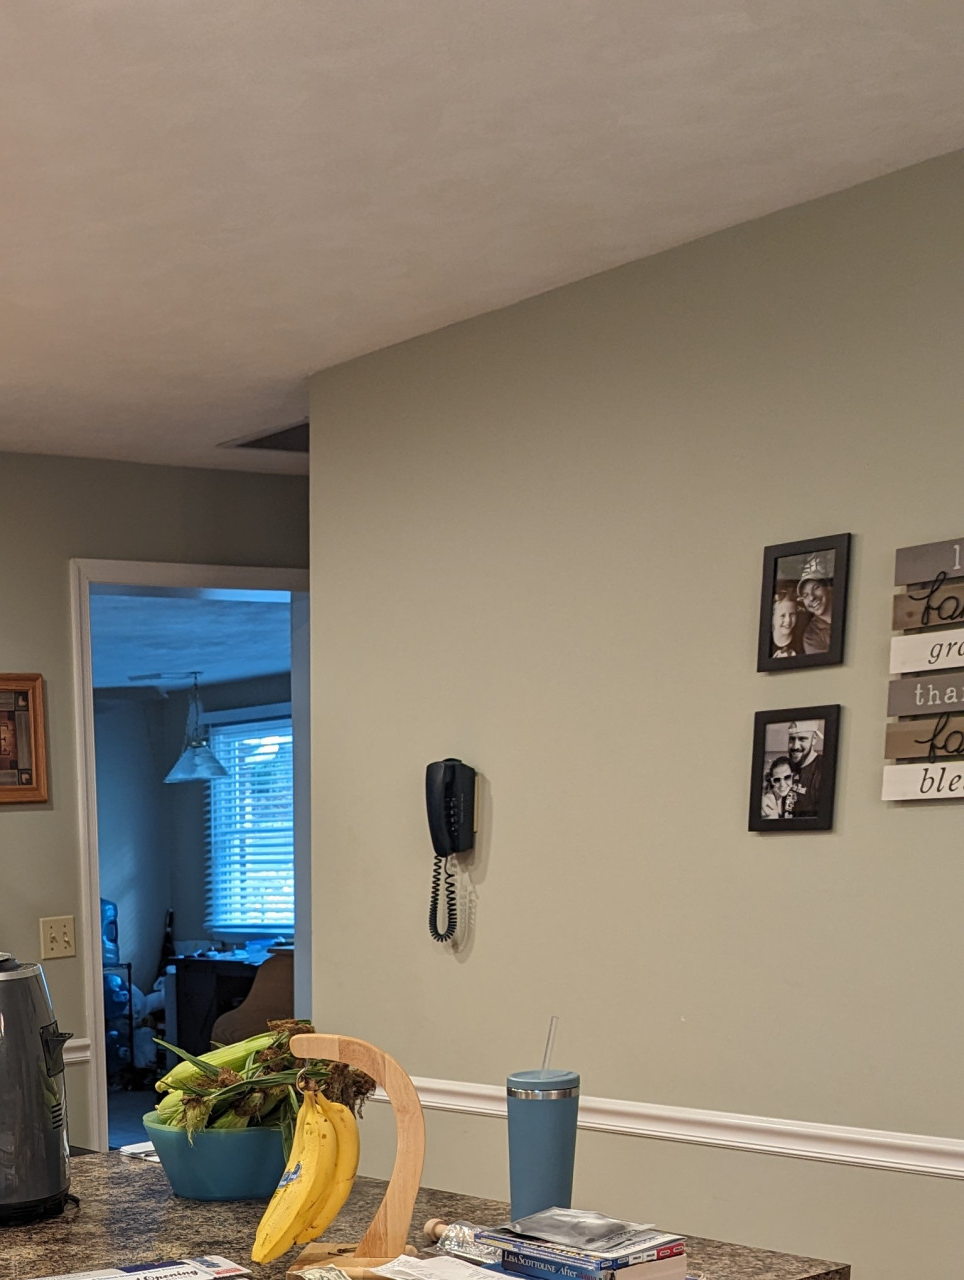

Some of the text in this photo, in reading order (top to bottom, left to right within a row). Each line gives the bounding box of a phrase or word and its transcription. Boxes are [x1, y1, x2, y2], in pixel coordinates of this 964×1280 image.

[504, 1251, 518, 1263] LISA
[518, 1254, 557, 1273] SCOTTOLINE
[558, 1266, 577, 1278] After
